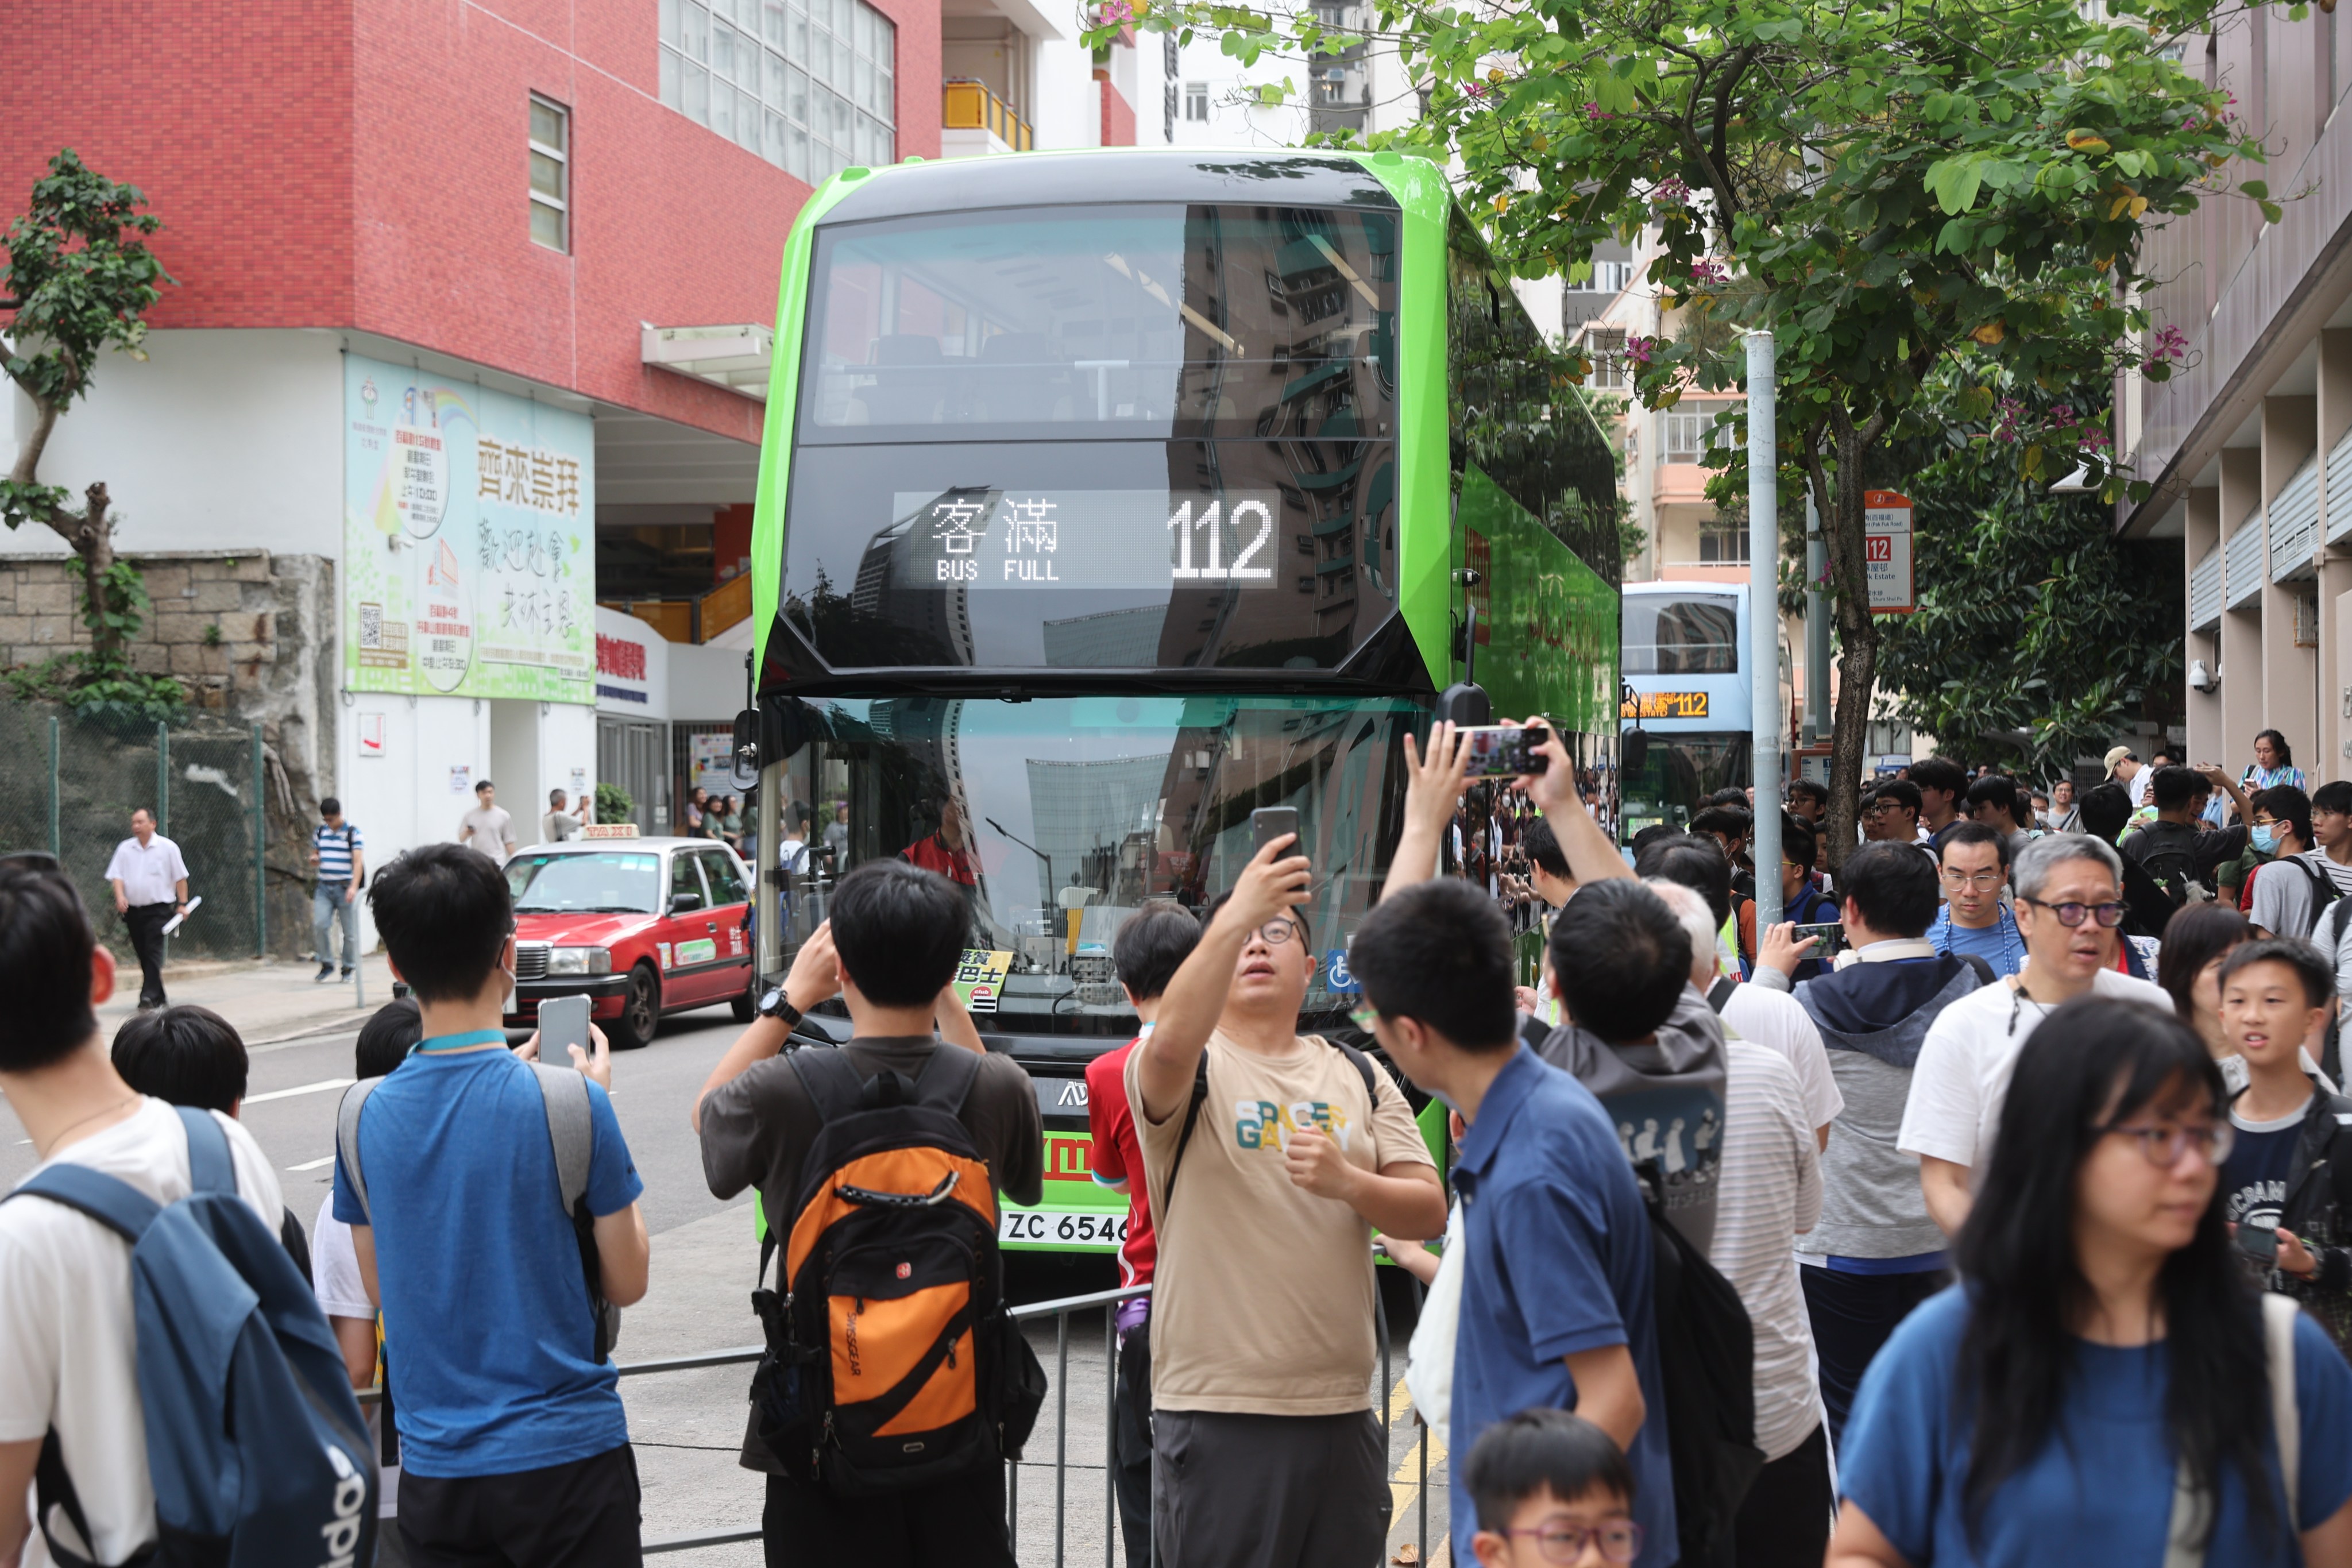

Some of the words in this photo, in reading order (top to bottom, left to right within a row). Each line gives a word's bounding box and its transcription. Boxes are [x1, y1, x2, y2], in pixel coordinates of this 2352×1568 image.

[478, 439, 580, 516] 齊來崇拜
[1167, 500, 1272, 579] 112
[937, 560, 978, 581] BUS
[1005, 560, 1059, 581] FULL
[1677, 692, 1707, 716] 112
[586, 825, 632, 837] TAXI
[730, 940, 743, 955] TAXI
[1008, 1214, 1045, 1239] ZC
[847, 1312, 861, 1376] SWISSGEAR
